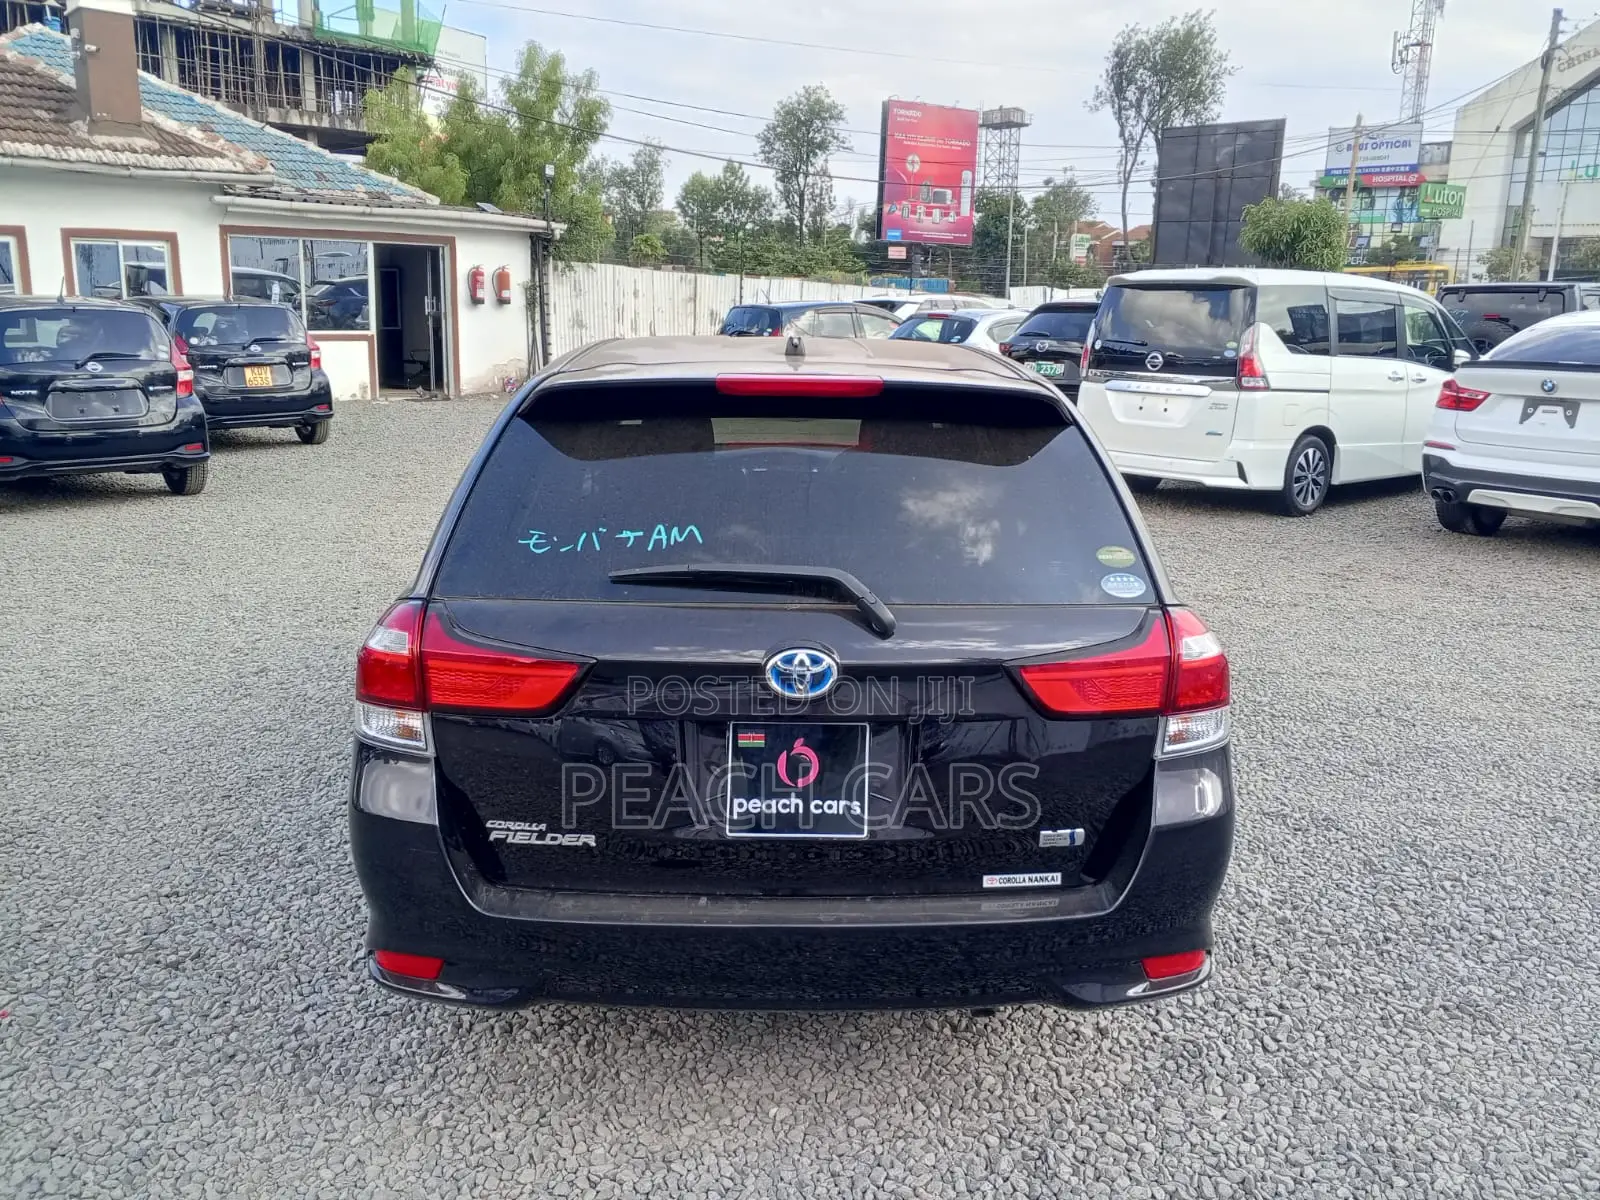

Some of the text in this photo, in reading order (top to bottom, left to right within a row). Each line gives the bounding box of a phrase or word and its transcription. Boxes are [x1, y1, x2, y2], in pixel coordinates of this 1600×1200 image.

[1371, 139, 1412, 150] OPTICAL
[1372, 174, 1407, 184] HOSPITAL
[1424, 183, 1465, 206] Luton
[1432, 207, 1462, 217] HOSPITAL
[733, 791, 862, 820] peach cars
[485, 819, 547, 831] COROLLA
[488, 830, 597, 847] FIELDER
[998, 874, 1059, 885] COROLLA NANKAI
